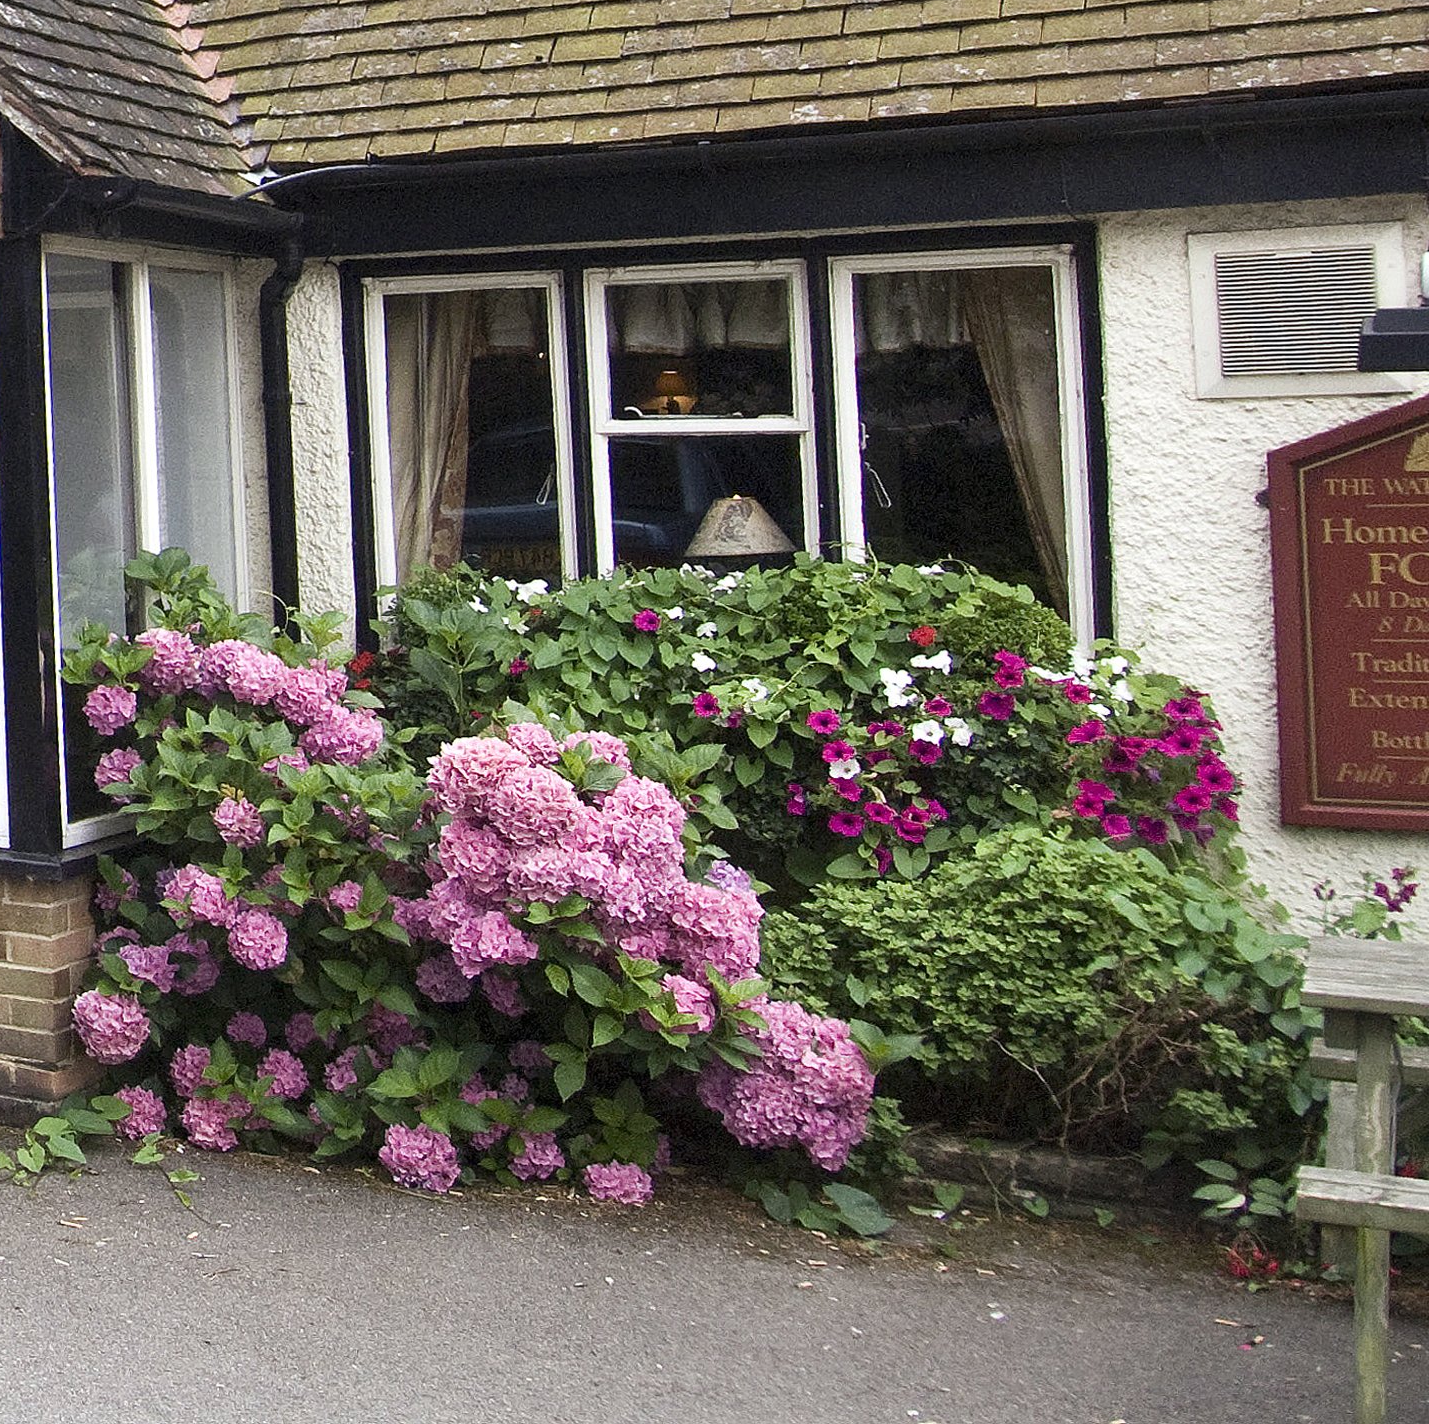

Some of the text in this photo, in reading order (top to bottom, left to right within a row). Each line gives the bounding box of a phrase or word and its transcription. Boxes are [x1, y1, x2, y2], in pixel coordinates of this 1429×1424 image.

[1324, 477, 1375, 496] THE
[1321, 517, 1429, 545] Home
[1344, 590, 1381, 609] All
[1336, 762, 1397, 788] Fully
